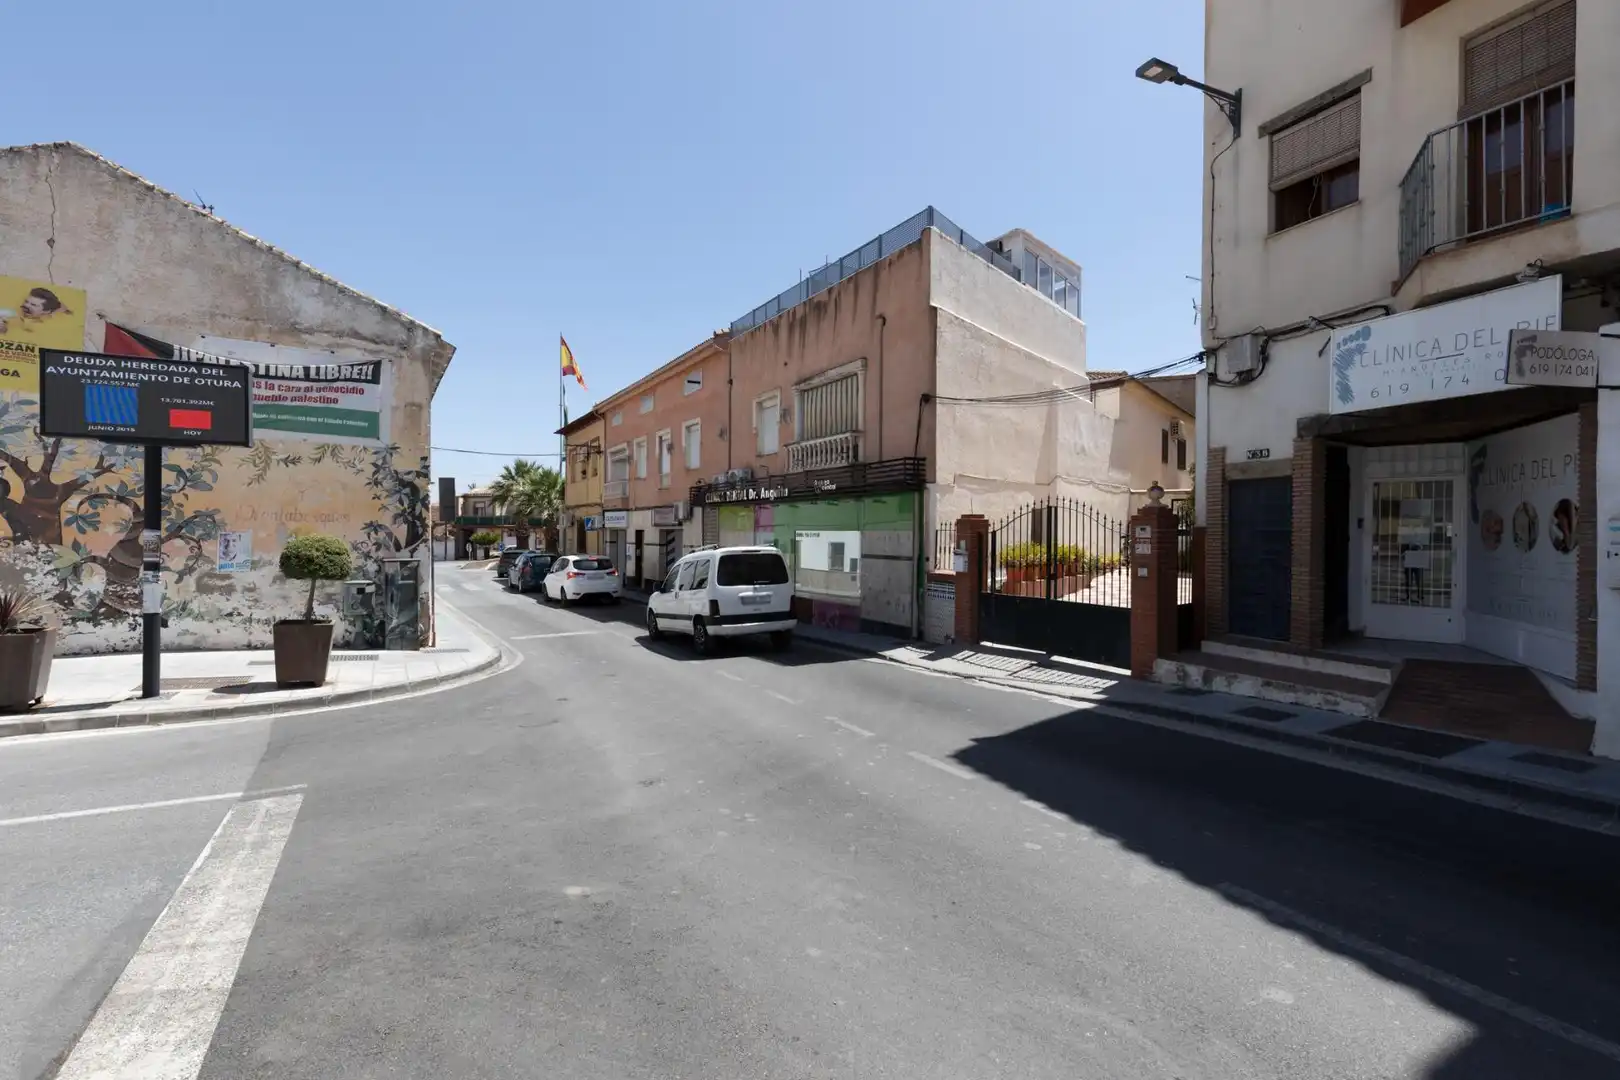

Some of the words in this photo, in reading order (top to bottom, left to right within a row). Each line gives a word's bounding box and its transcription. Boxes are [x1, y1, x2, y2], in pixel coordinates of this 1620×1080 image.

[1455, 327, 1502, 352] DEL
[1530, 345, 1595, 361] PODÓLOGA
[63, 355, 117, 367] DEUDA
[121, 360, 198, 374] HEREDADA
[202, 367, 228, 377] DEL
[1529, 363, 1550, 374] 619
[1554, 364, 1572, 376] 174
[1575, 365, 1595, 377] 041
[46, 365, 169, 382] AYUNTAMIENTO
[173, 376, 191, 385] DE
[194, 378, 242, 388] OTURA
[264, 381, 275, 391] la
[277, 384, 301, 393] cara
[303, 385, 313, 393] al
[315, 385, 365, 395] genocidio
[1371, 382, 1409, 398] 619
[1430, 373, 1470, 390] 174
[290, 394, 339, 404] palestino
[87, 424, 114, 432] JUNIO
[1530, 458, 1557, 480] DEL
[1563, 453, 1578, 476] PI
[748, 488, 758, 500] Dr.
